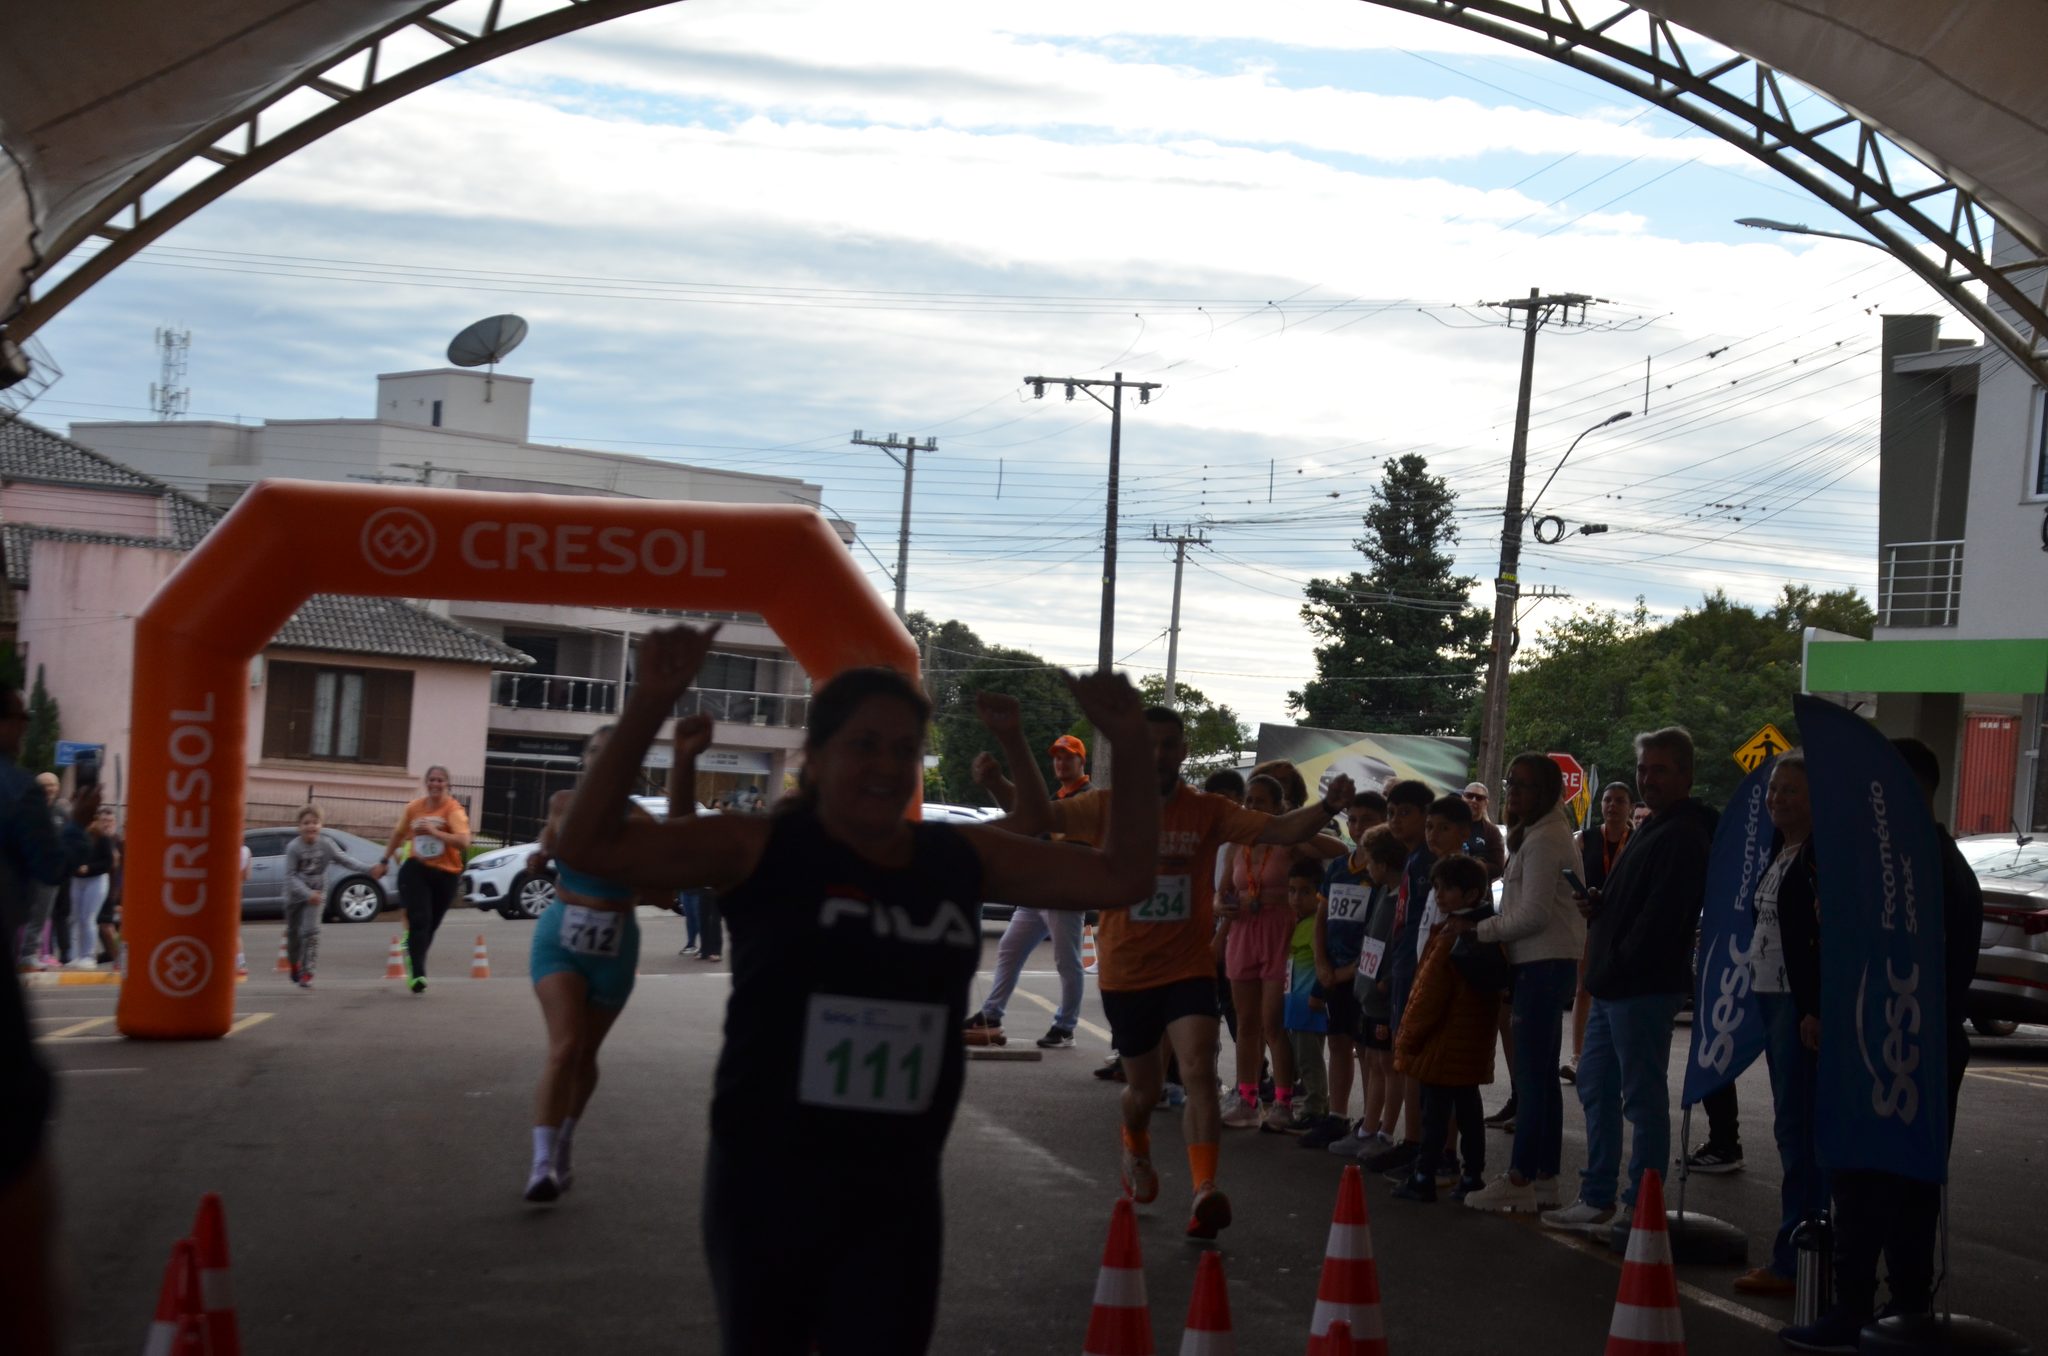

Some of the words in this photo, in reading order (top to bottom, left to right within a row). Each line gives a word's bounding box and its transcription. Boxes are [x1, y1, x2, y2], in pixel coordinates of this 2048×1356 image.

[460, 520, 727, 578] CRESOL
[161, 692, 216, 916] CRESOL
[1562, 772, 1580, 787] RE
[1734, 784, 1762, 911] Fecomércio
[1870, 780, 1895, 931] Fecomércio
[816, 885, 977, 950] FILA
[1138, 891, 1185, 917] 234
[1330, 897, 1362, 918] 987
[570, 924, 617, 952] 712
[826, 1037, 925, 1101] 111
